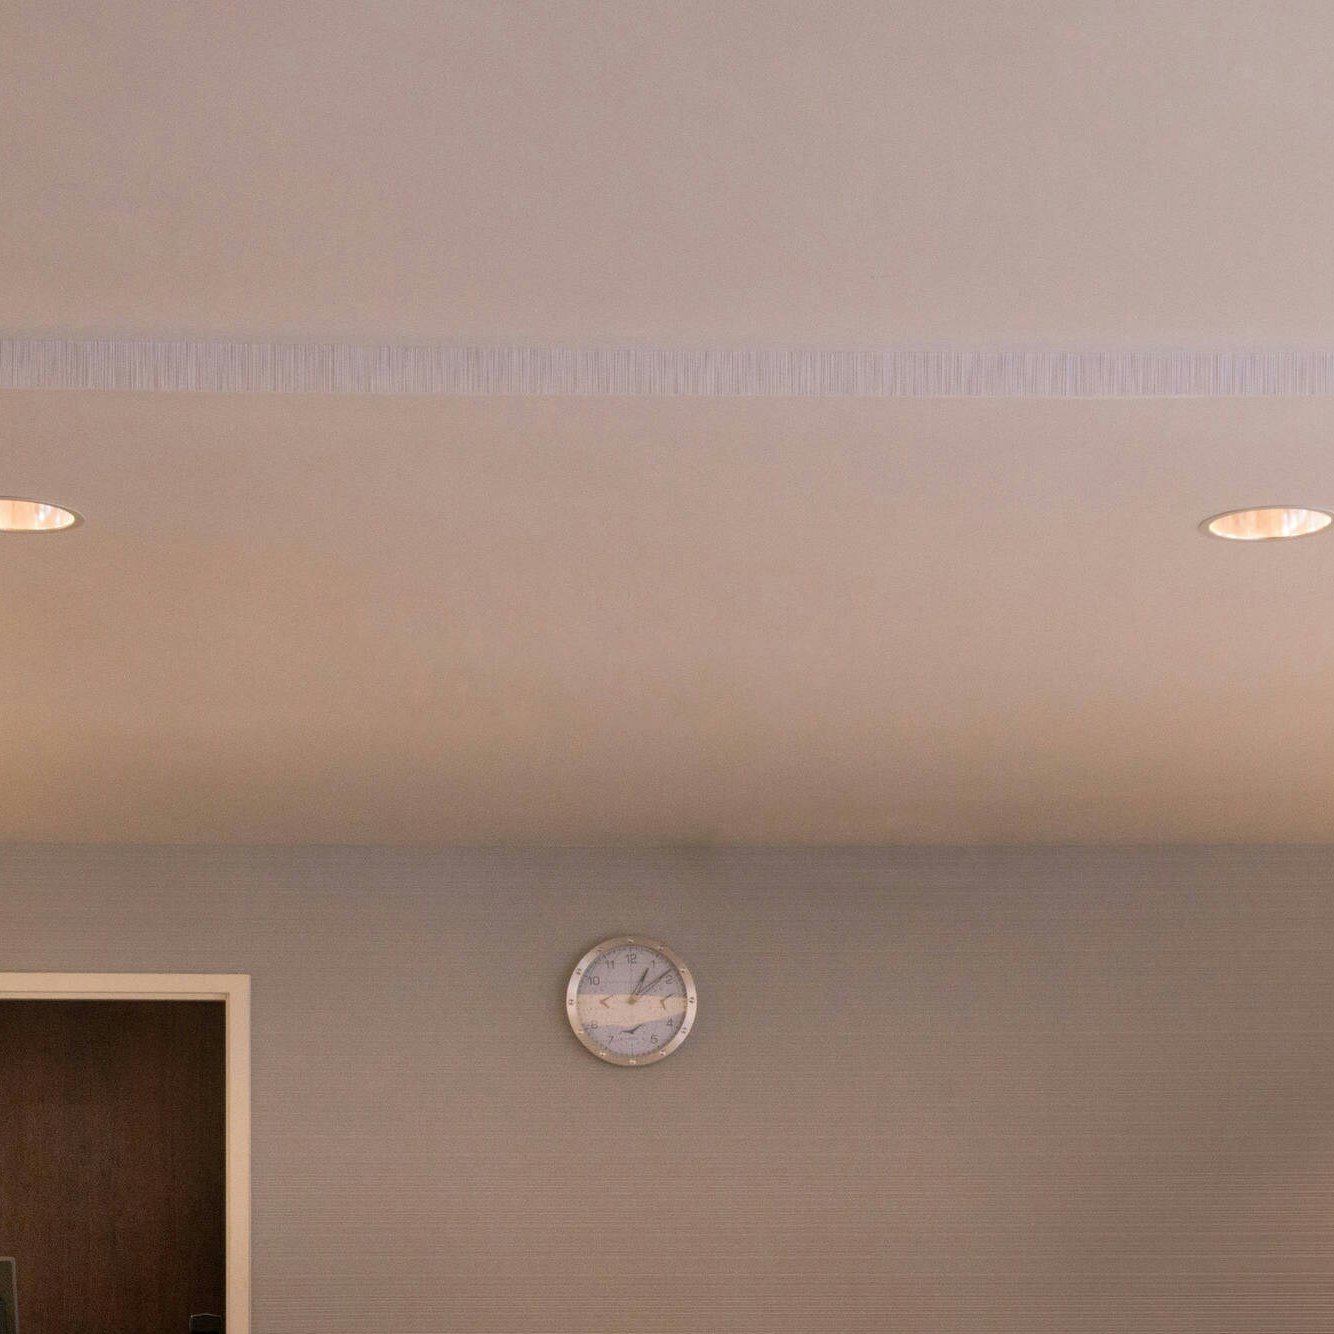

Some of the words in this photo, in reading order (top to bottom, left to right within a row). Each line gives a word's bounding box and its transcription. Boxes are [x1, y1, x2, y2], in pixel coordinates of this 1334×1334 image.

[626, 953, 637, 964] 12
[605, 960, 616, 969] 11
[587, 975, 600, 986] 10
[665, 975, 673, 985] 2
[667, 1018, 673, 1027] 4
[608, 1035, 614, 1044] 7
[650, 1034, 658, 1044] 5
